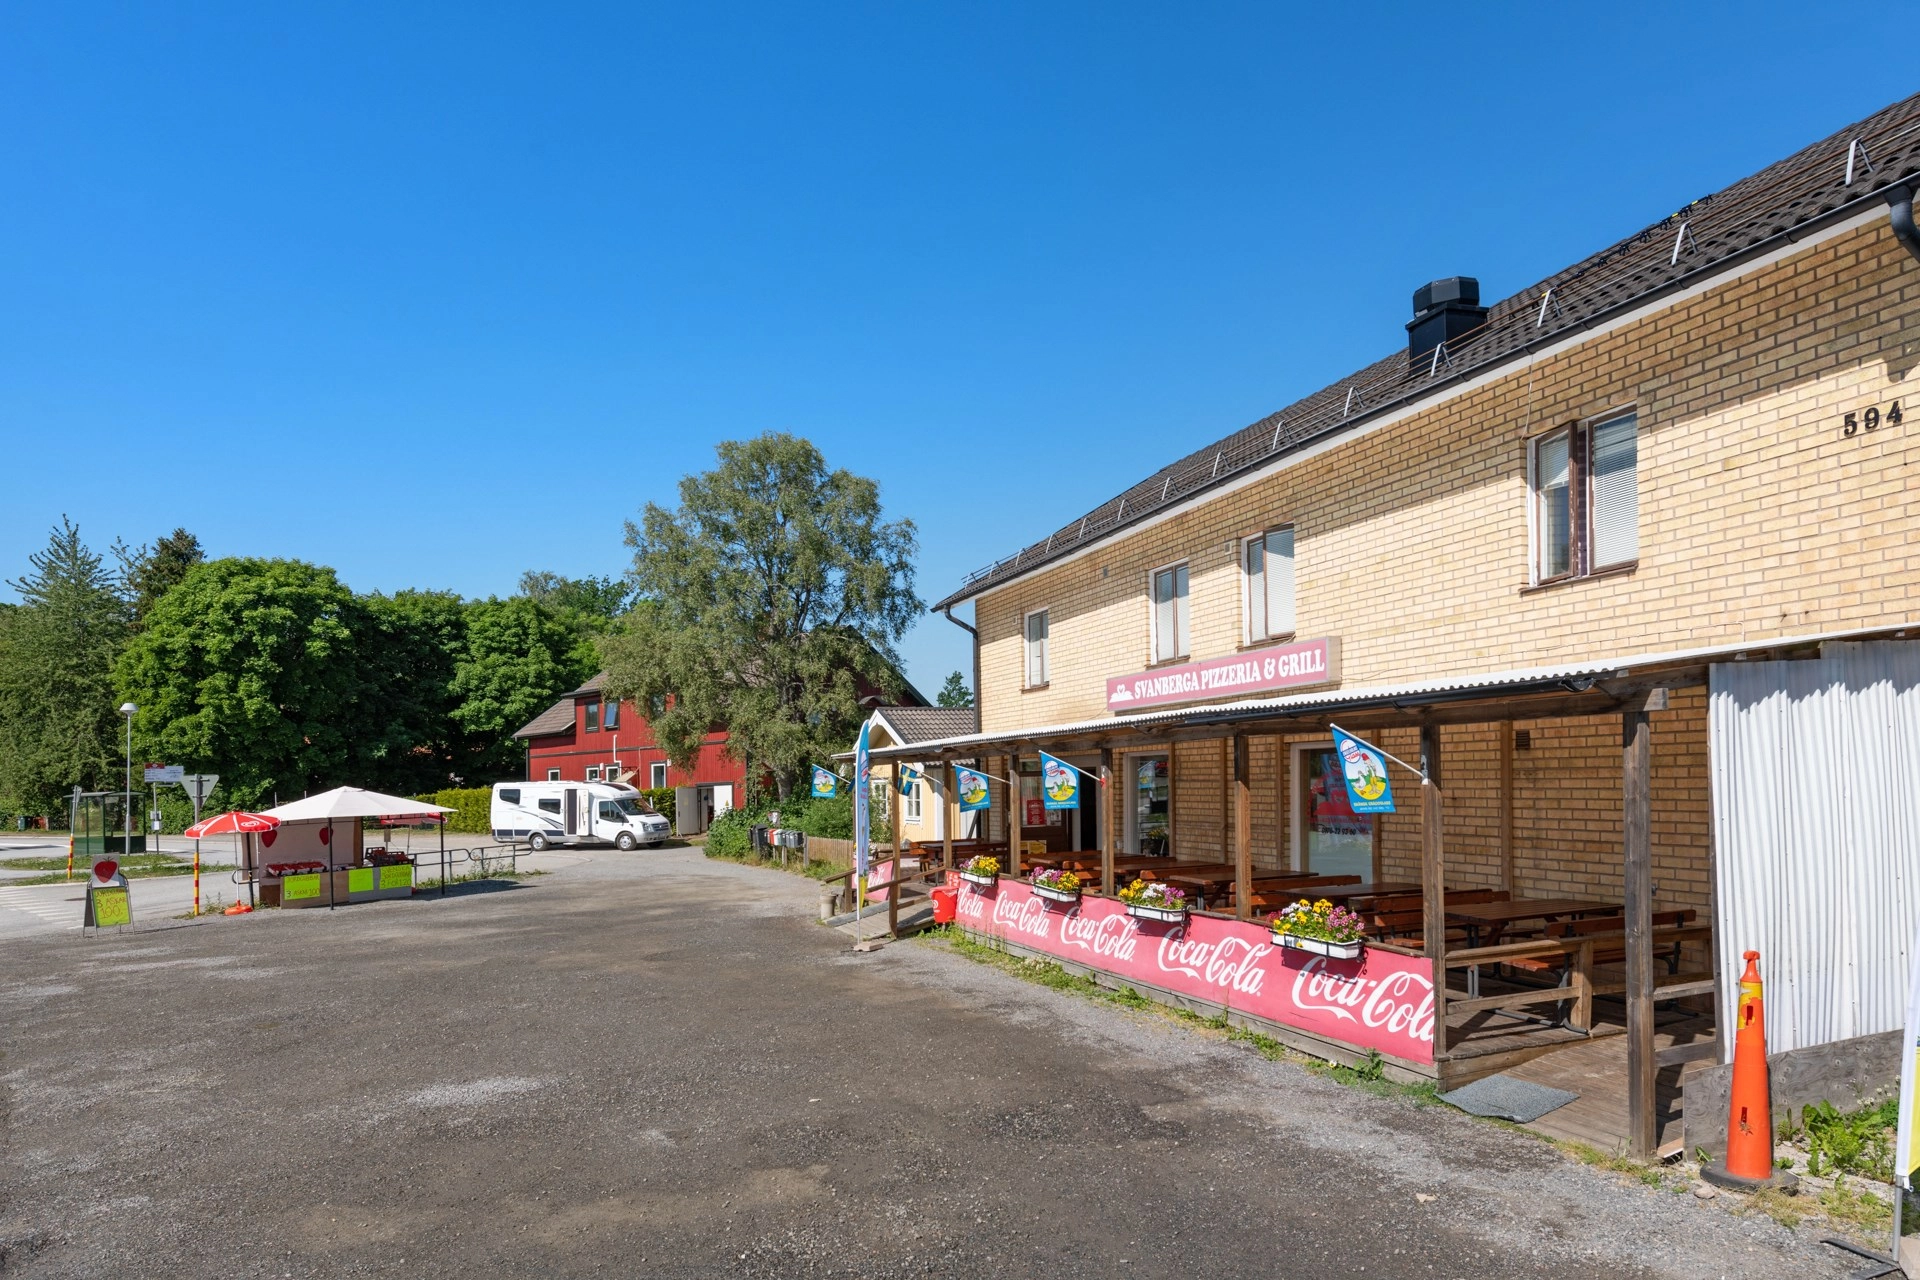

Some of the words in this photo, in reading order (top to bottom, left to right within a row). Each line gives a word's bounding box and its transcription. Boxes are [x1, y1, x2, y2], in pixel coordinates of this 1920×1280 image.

[1844, 400, 1903, 436] 594
[1134, 671, 1199, 700] SVANBERGA
[1200, 661, 1261, 690] PIZZERIA
[1263, 658, 1276, 680] &
[1278, 649, 1325, 678] GRILL
[286, 890, 292, 899] 3
[993, 890, 1052, 937] Coca-Cola
[1060, 906, 1138, 961] Coca-Cola
[1158, 927, 1270, 995] Coca-Cola
